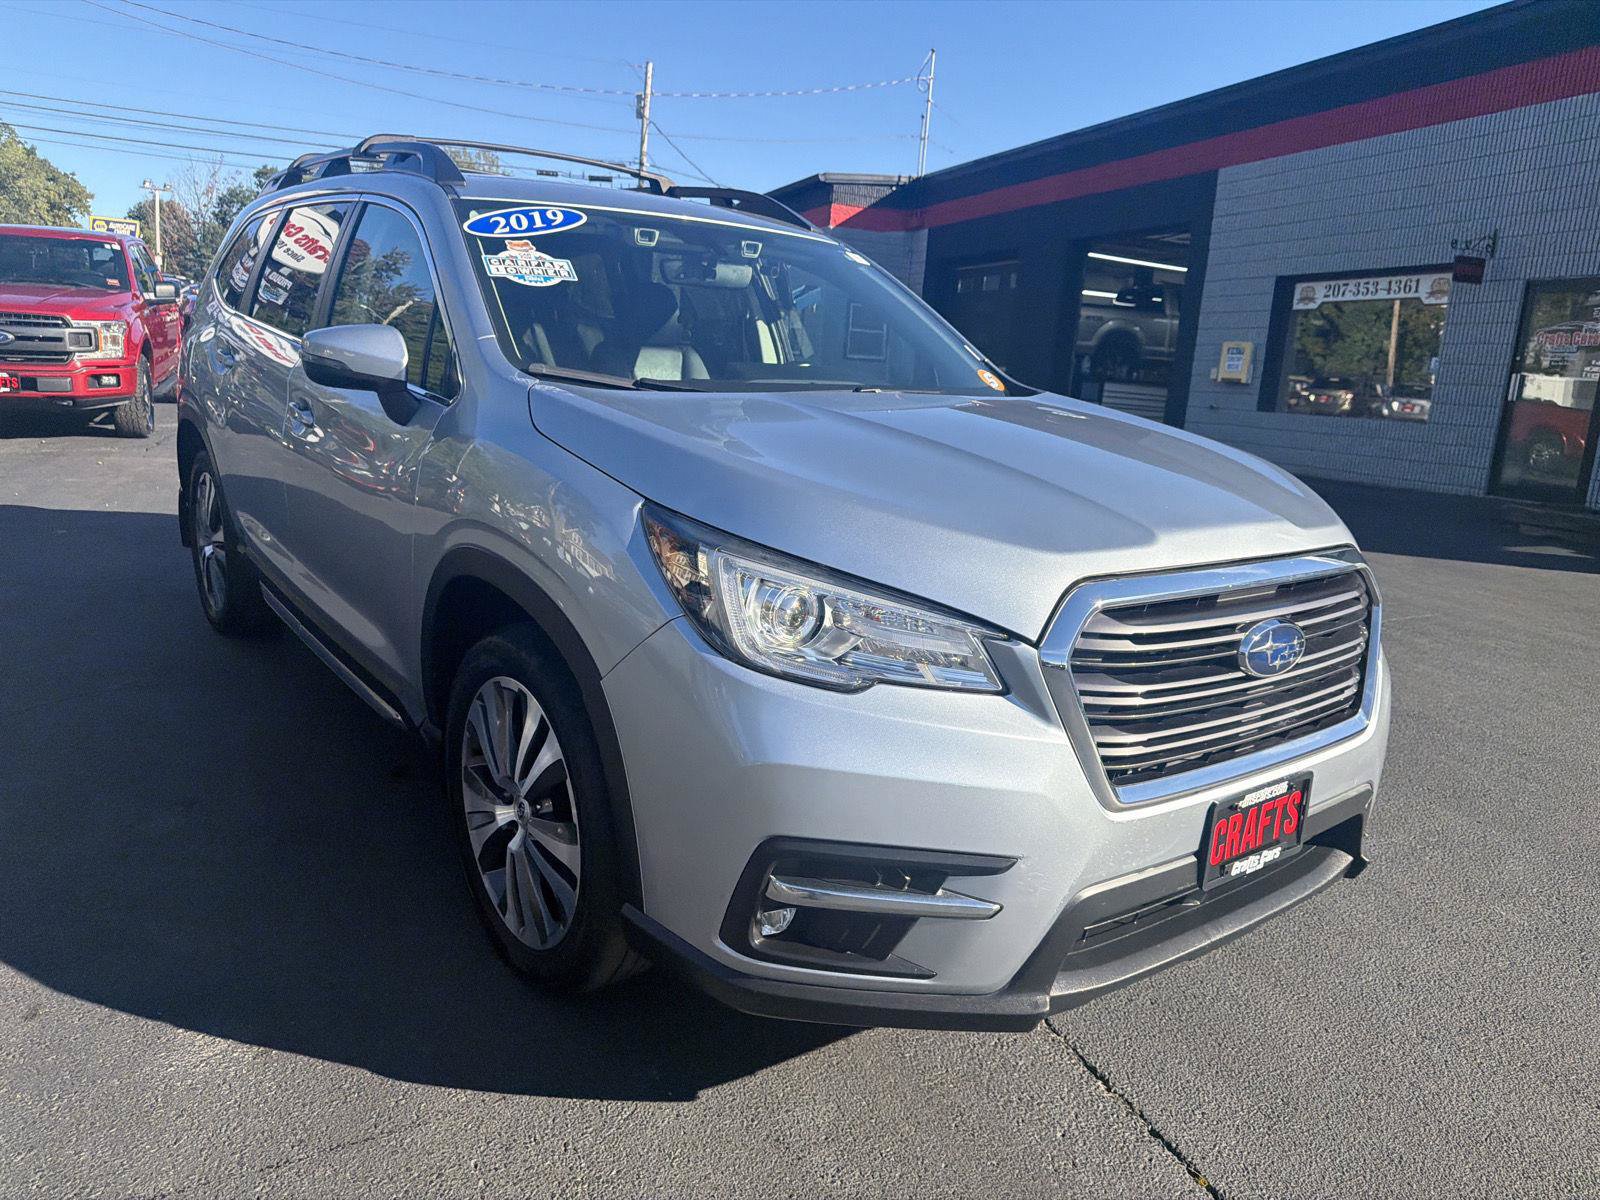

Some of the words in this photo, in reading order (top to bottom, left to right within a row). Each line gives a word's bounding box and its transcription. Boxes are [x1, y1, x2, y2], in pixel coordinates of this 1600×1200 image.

[489, 209, 564, 234] 2019
[488, 258, 566, 270] CARFAX
[505, 266, 571, 278] OWNER
[1323, 278, 1421, 298] 207-353-4361
[1210, 790, 1302, 866] CRAFTS
